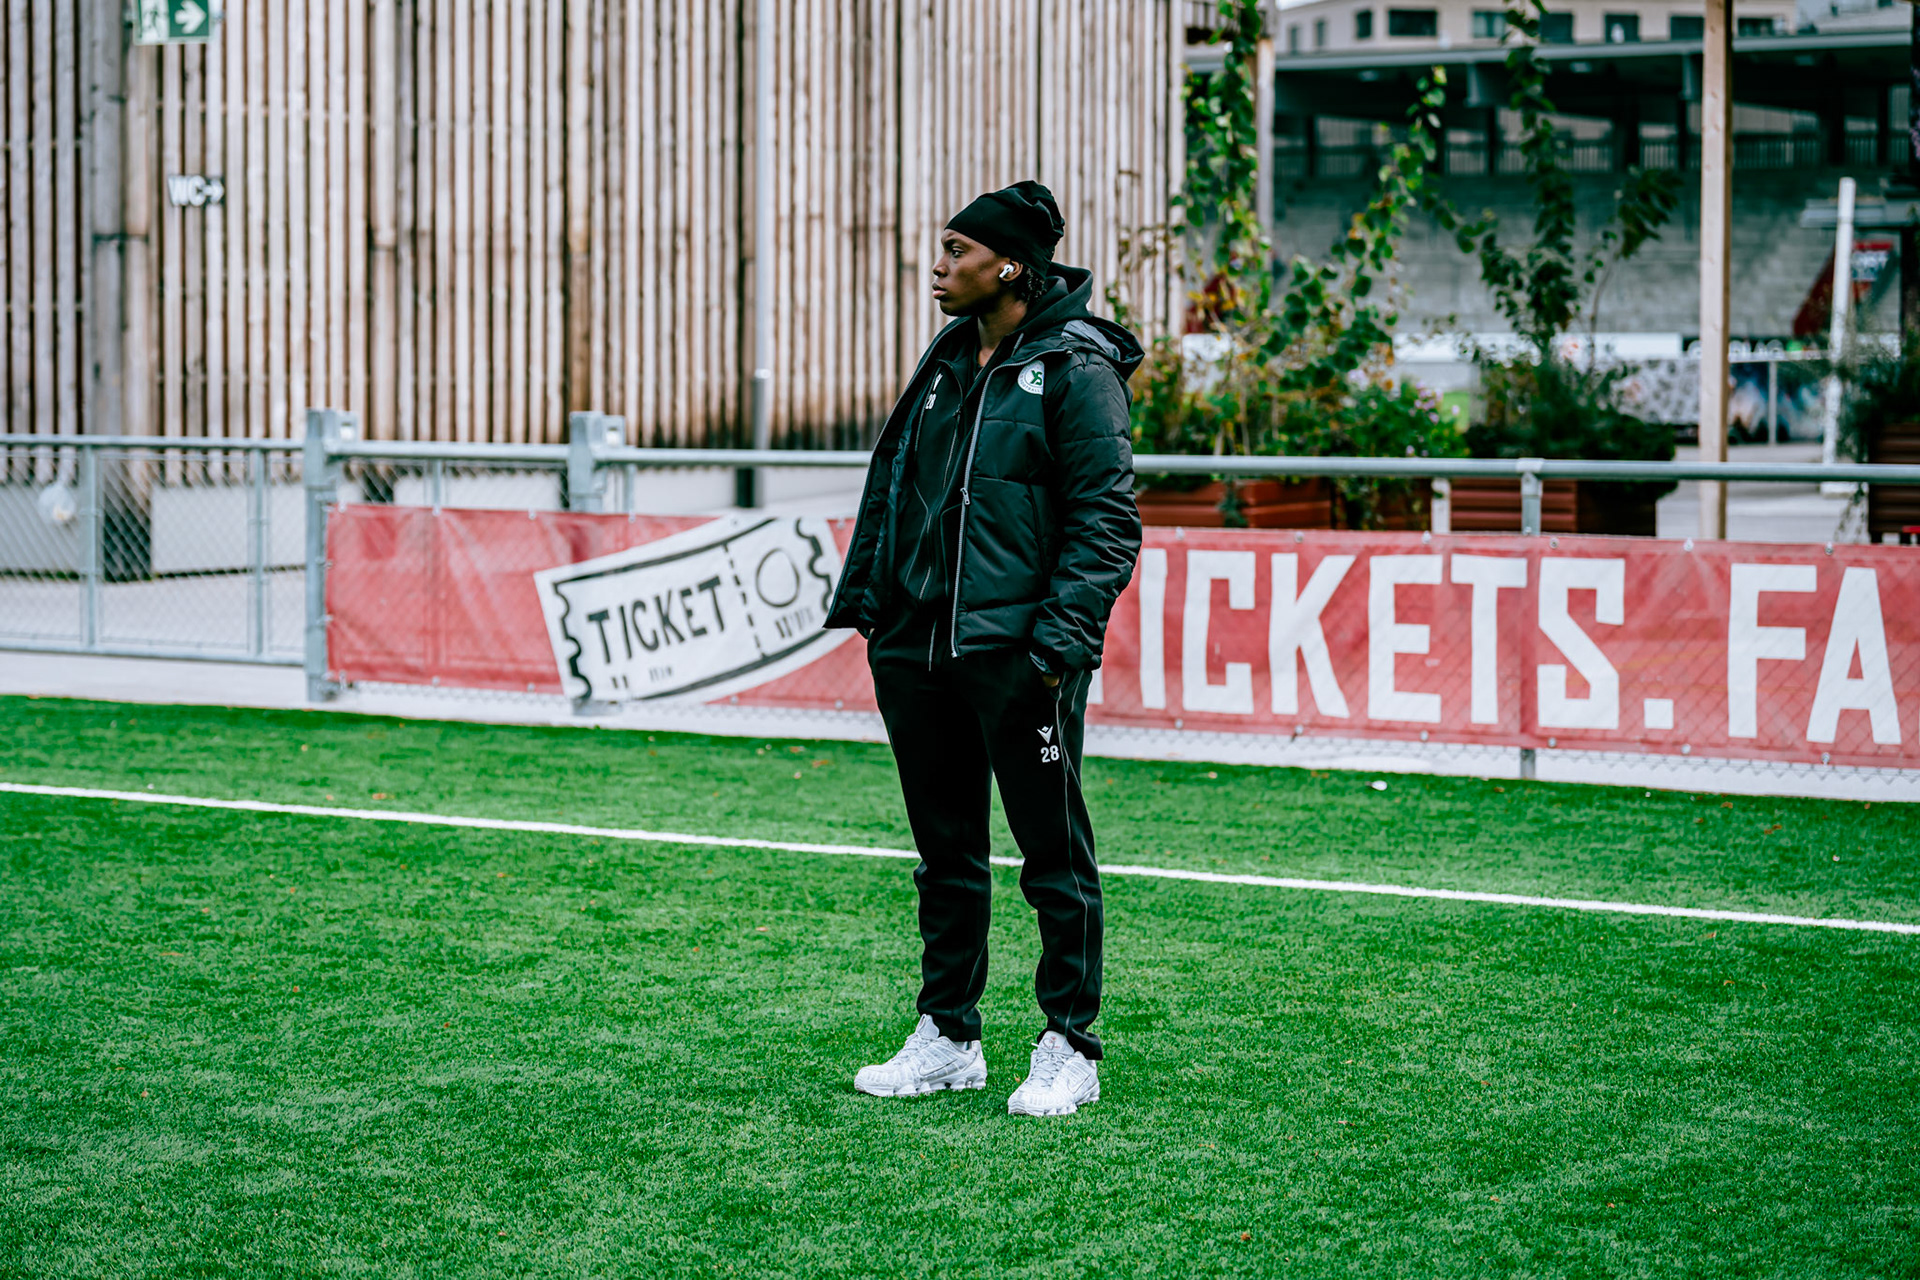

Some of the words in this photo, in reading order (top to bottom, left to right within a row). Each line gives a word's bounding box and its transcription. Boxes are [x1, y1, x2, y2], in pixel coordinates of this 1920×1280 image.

[168, 175, 206, 207] WC
[925, 393, 937, 409] 28
[587, 576, 726, 664] TICKET
[1087, 547, 1674, 730] ICKETS.
[1728, 563, 1920, 745] FA
[1040, 744, 1060, 763] 28
